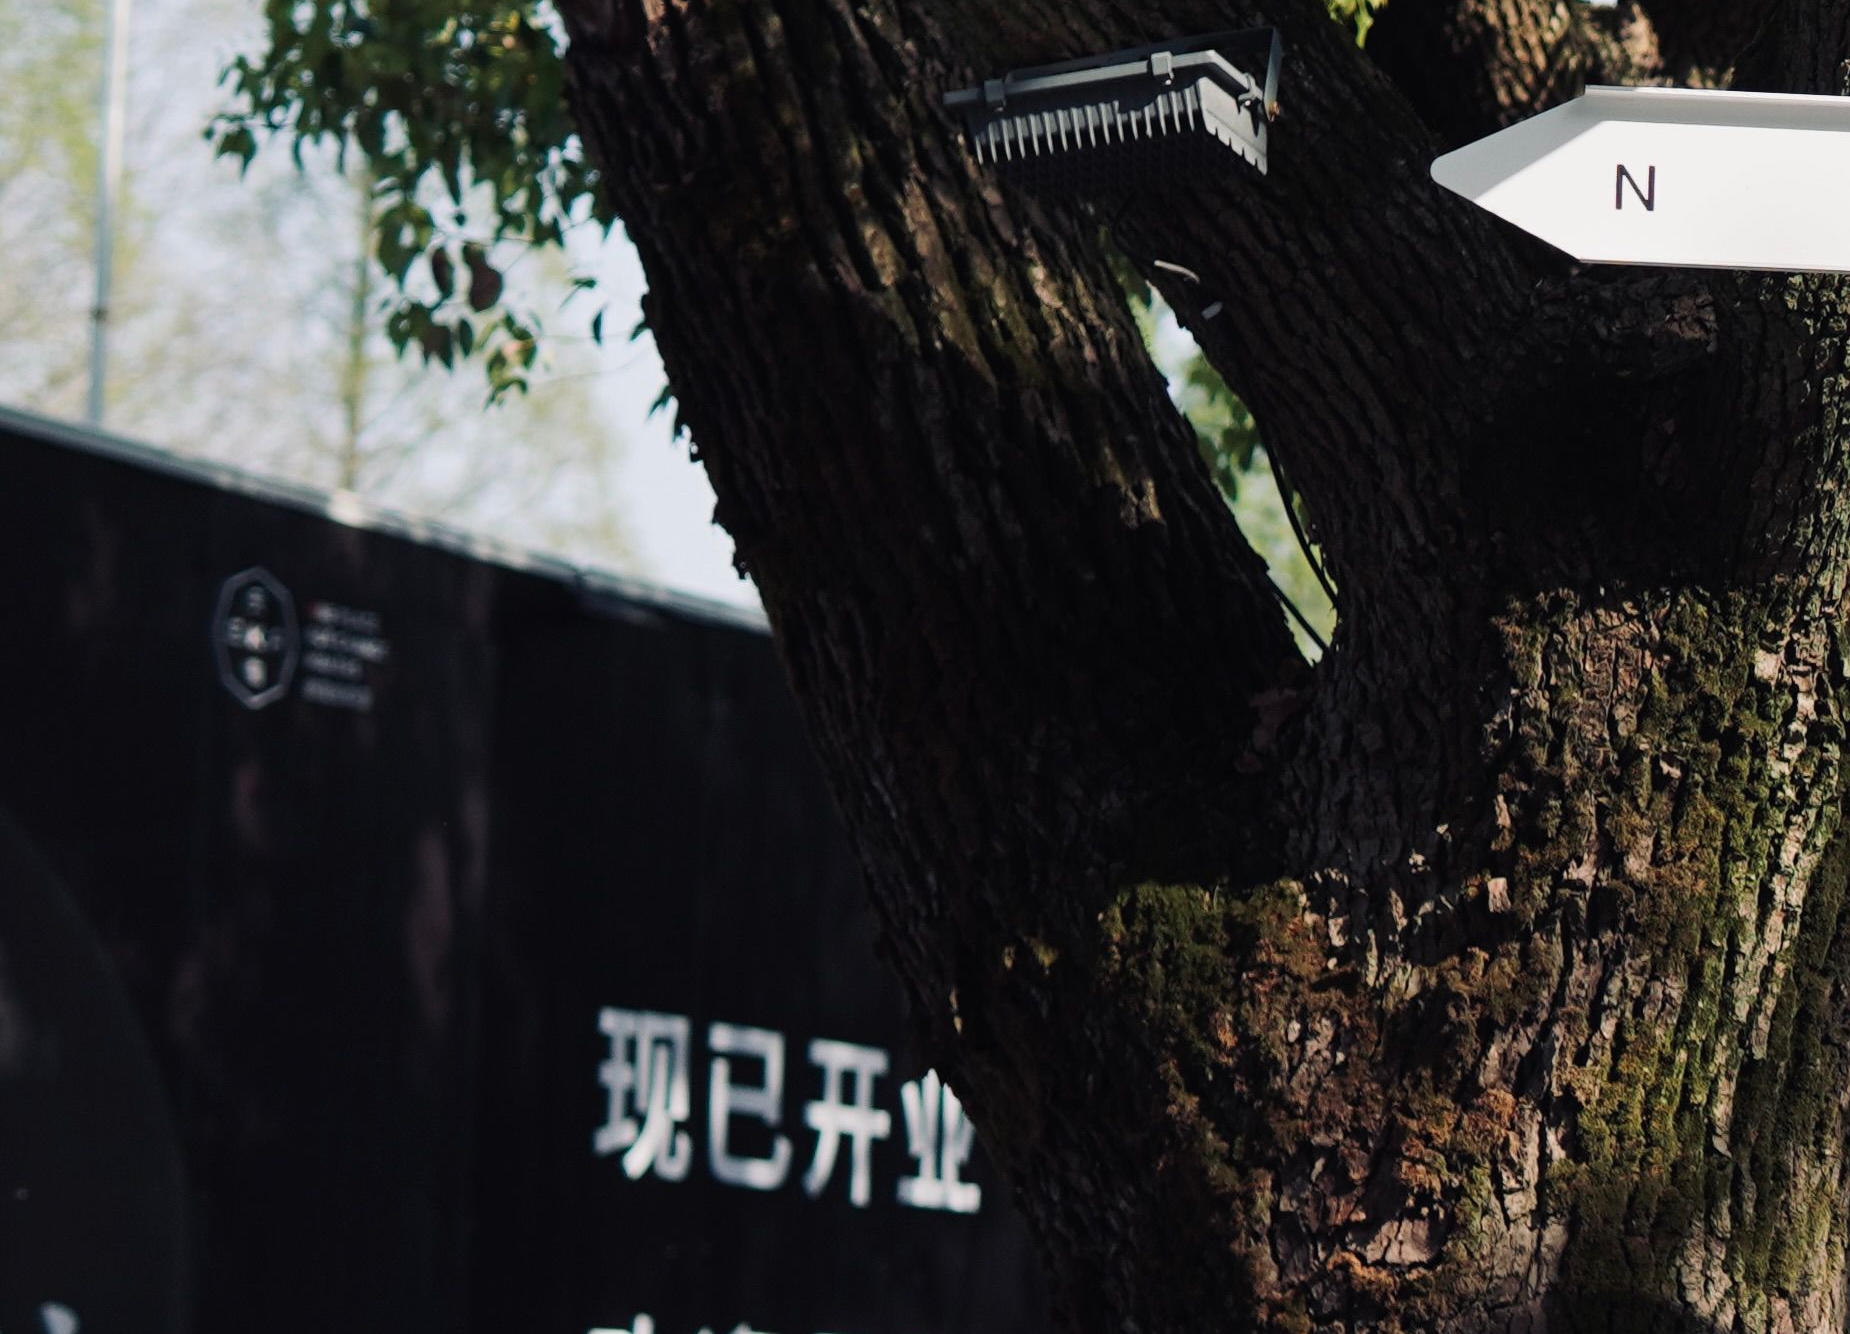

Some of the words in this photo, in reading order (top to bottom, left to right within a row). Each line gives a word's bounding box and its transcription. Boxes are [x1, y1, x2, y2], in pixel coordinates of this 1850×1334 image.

[1615, 163, 1656, 212] N
[595, 1006, 981, 1212] 现已开业
